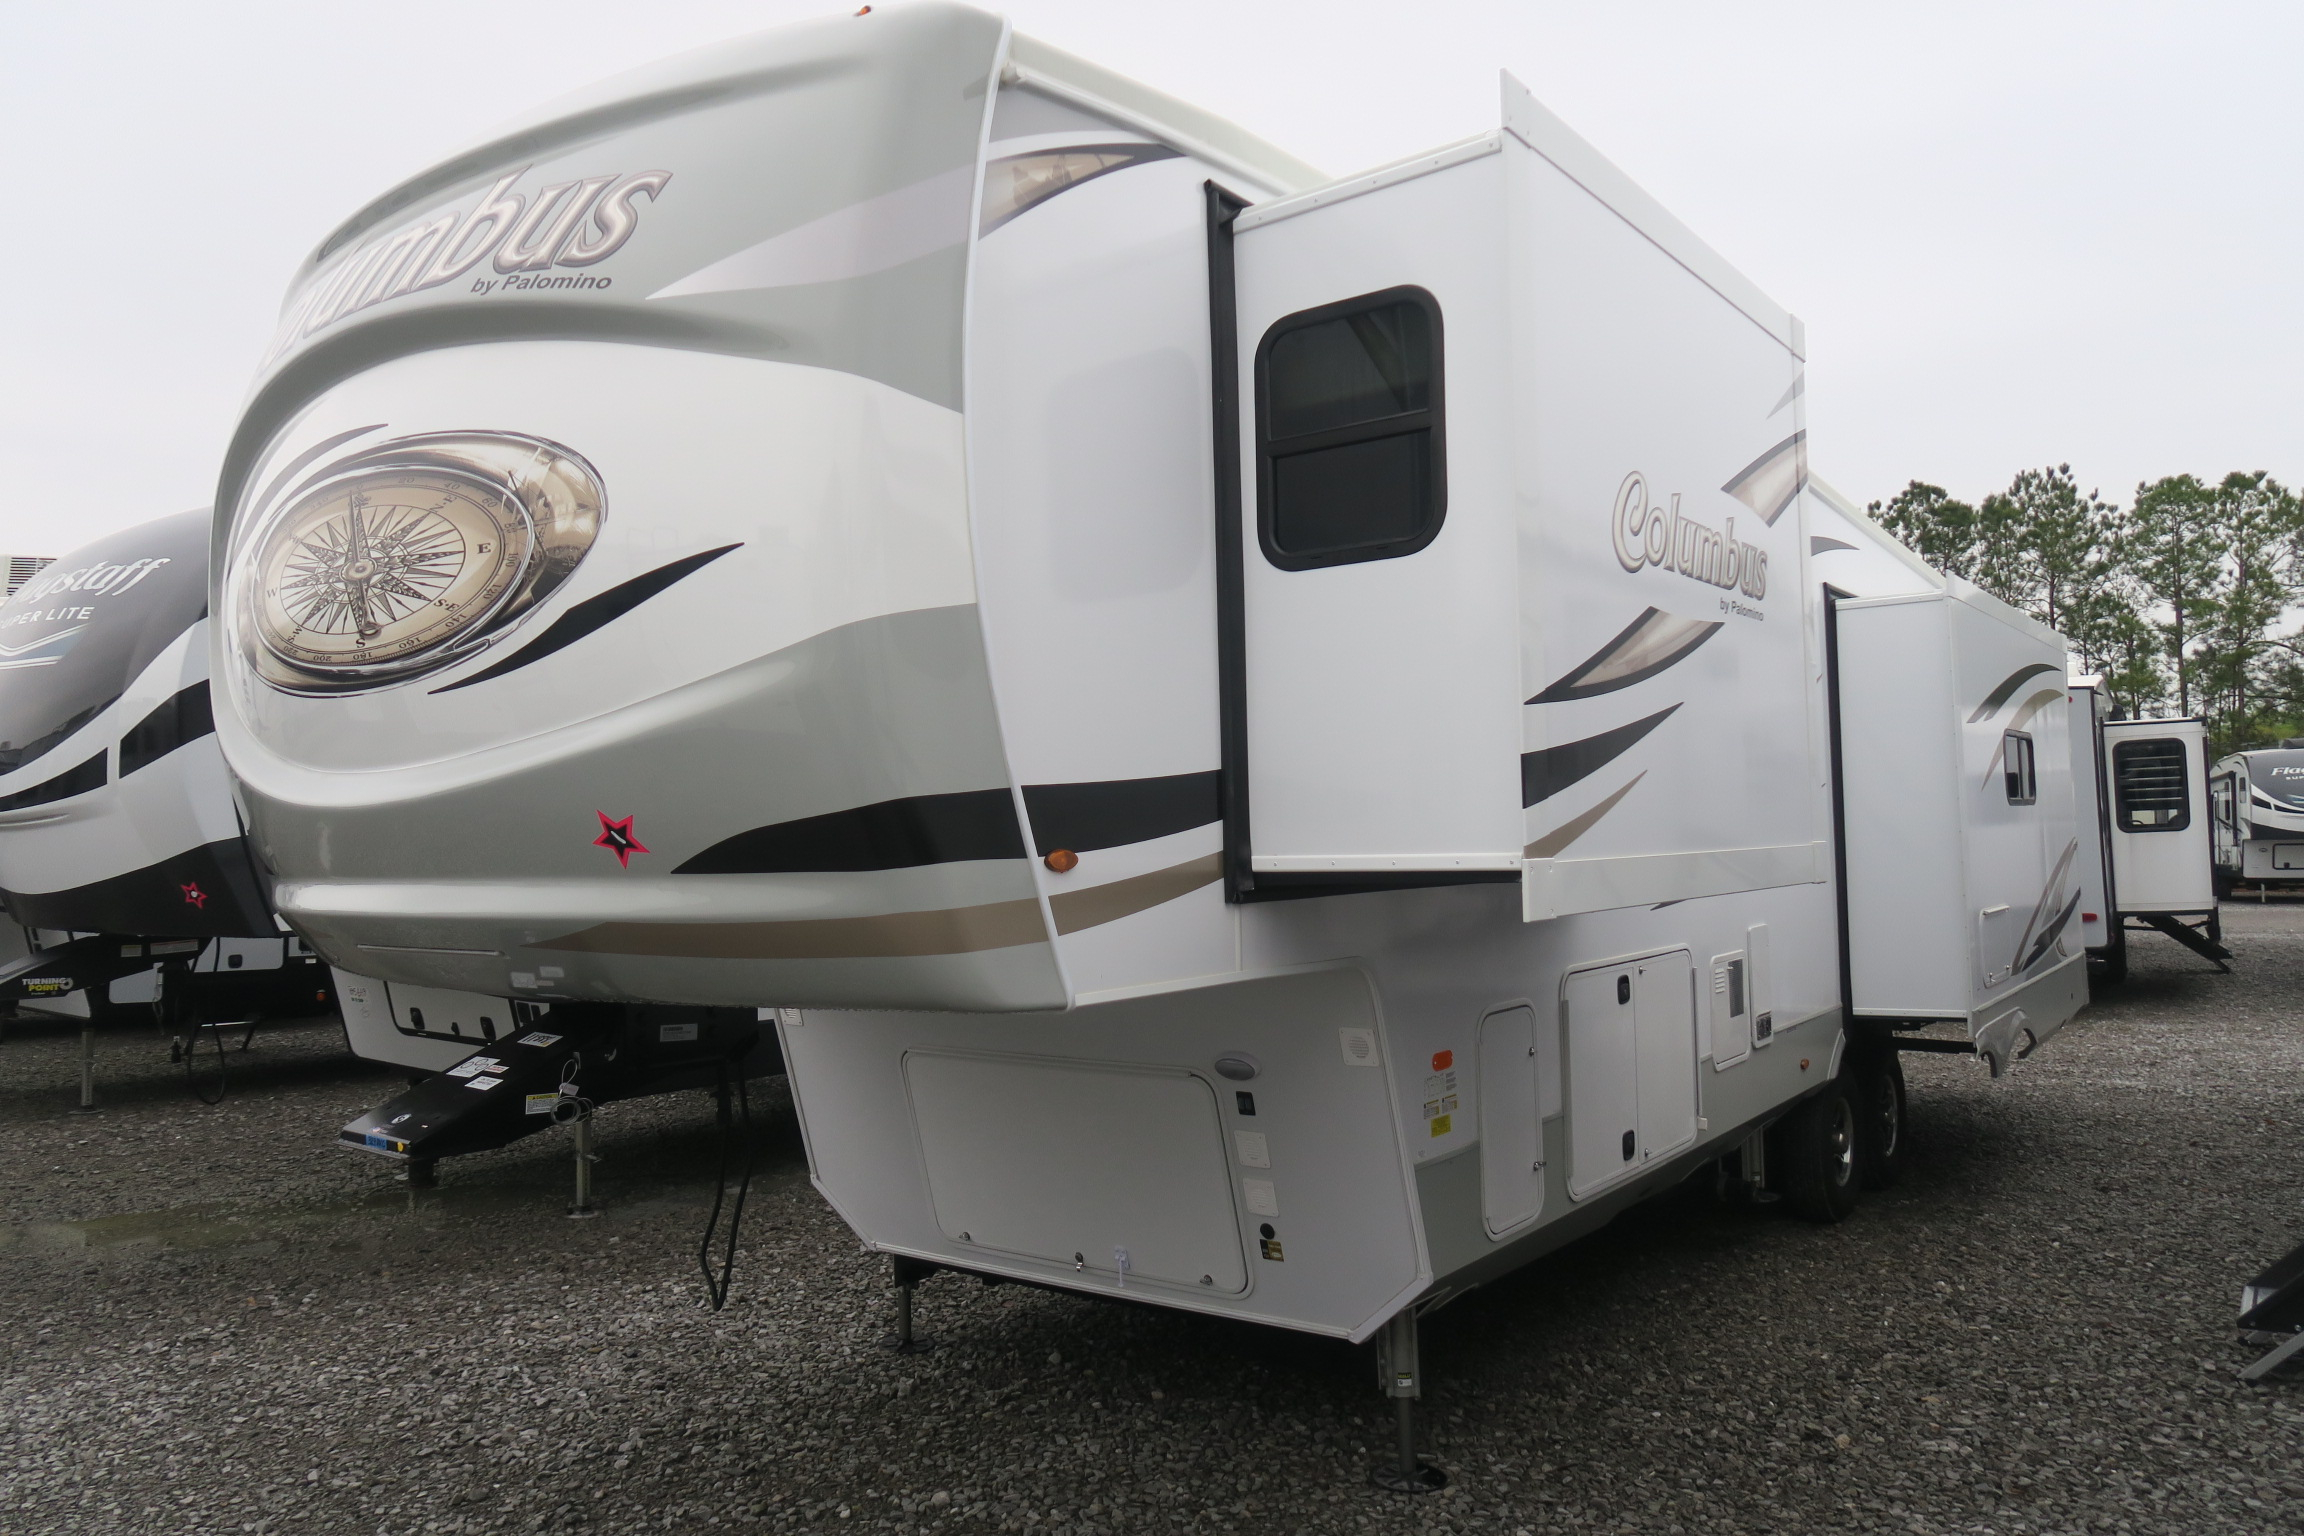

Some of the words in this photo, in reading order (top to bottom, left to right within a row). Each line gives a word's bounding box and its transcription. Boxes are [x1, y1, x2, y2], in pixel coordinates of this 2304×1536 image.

[258, 163, 674, 377] olumbus
[470, 276, 498, 296] by
[501, 273, 612, 292] Palomino
[1611, 470, 1768, 601] Columbus
[476, 542, 492, 555] E
[505, 552, 518, 567] 100
[266, 587, 278, 598] W
[483, 583, 502, 600] 120
[45, 606, 95, 621] LITE
[1719, 597, 1730, 614] by
[1731, 600, 1764, 622] Palomino
[444, 613, 468, 628] 140
[22, 977, 67, 985] TURNING
